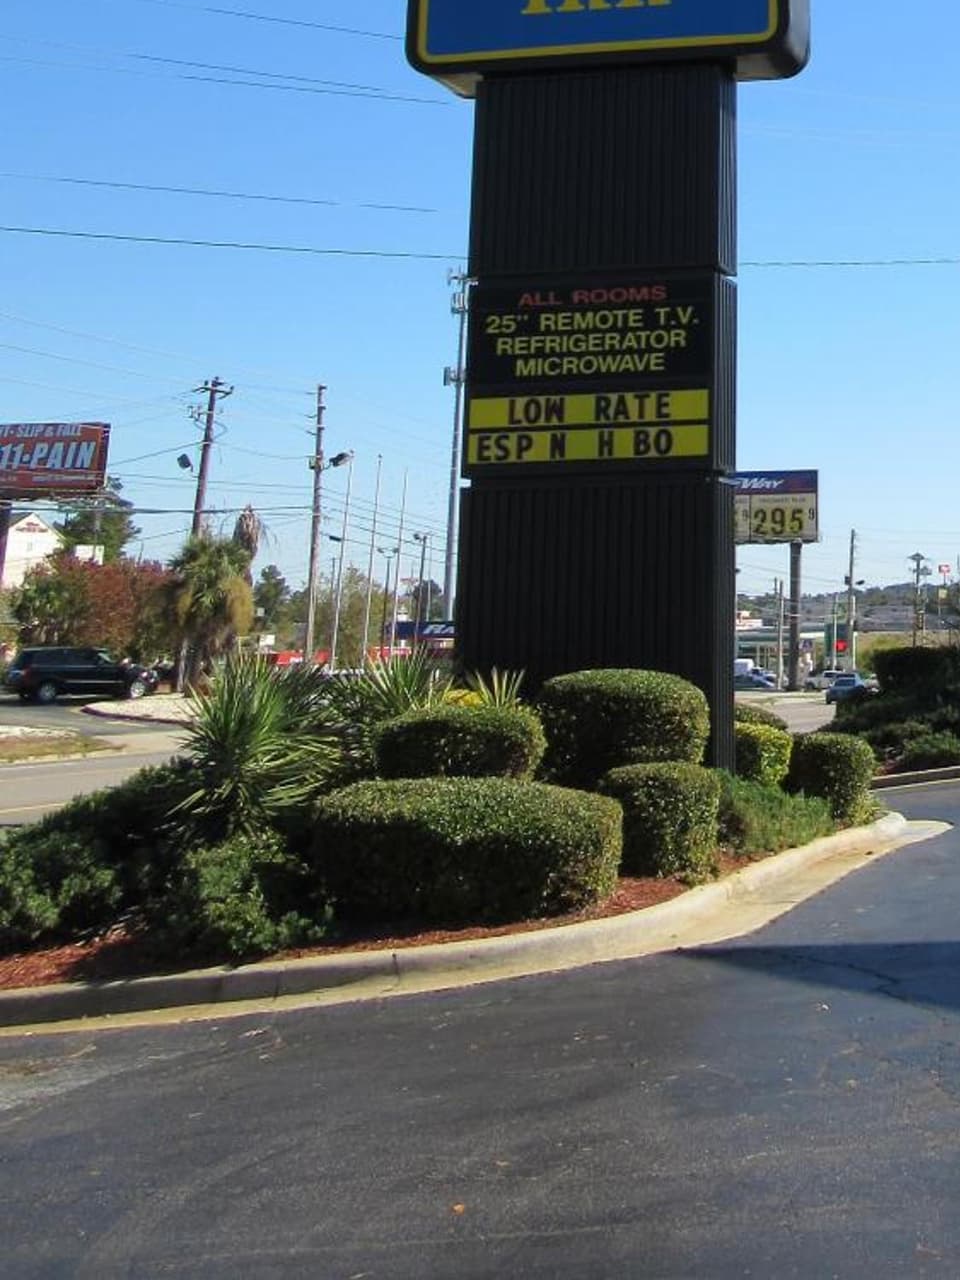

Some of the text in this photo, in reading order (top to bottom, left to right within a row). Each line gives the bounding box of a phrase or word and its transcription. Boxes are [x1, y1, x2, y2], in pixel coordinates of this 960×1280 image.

[519, 285, 668, 307] ALL ROOMS
[540, 308, 644, 332] REMOTE
[655, 305, 699, 325] T.V.
[496, 329, 687, 356] REFRIGERATOR
[515, 352, 666, 377] MICROWAVE
[507, 392, 671, 425] LOW RATE
[0, 441, 96, 470] 11-PAIN
